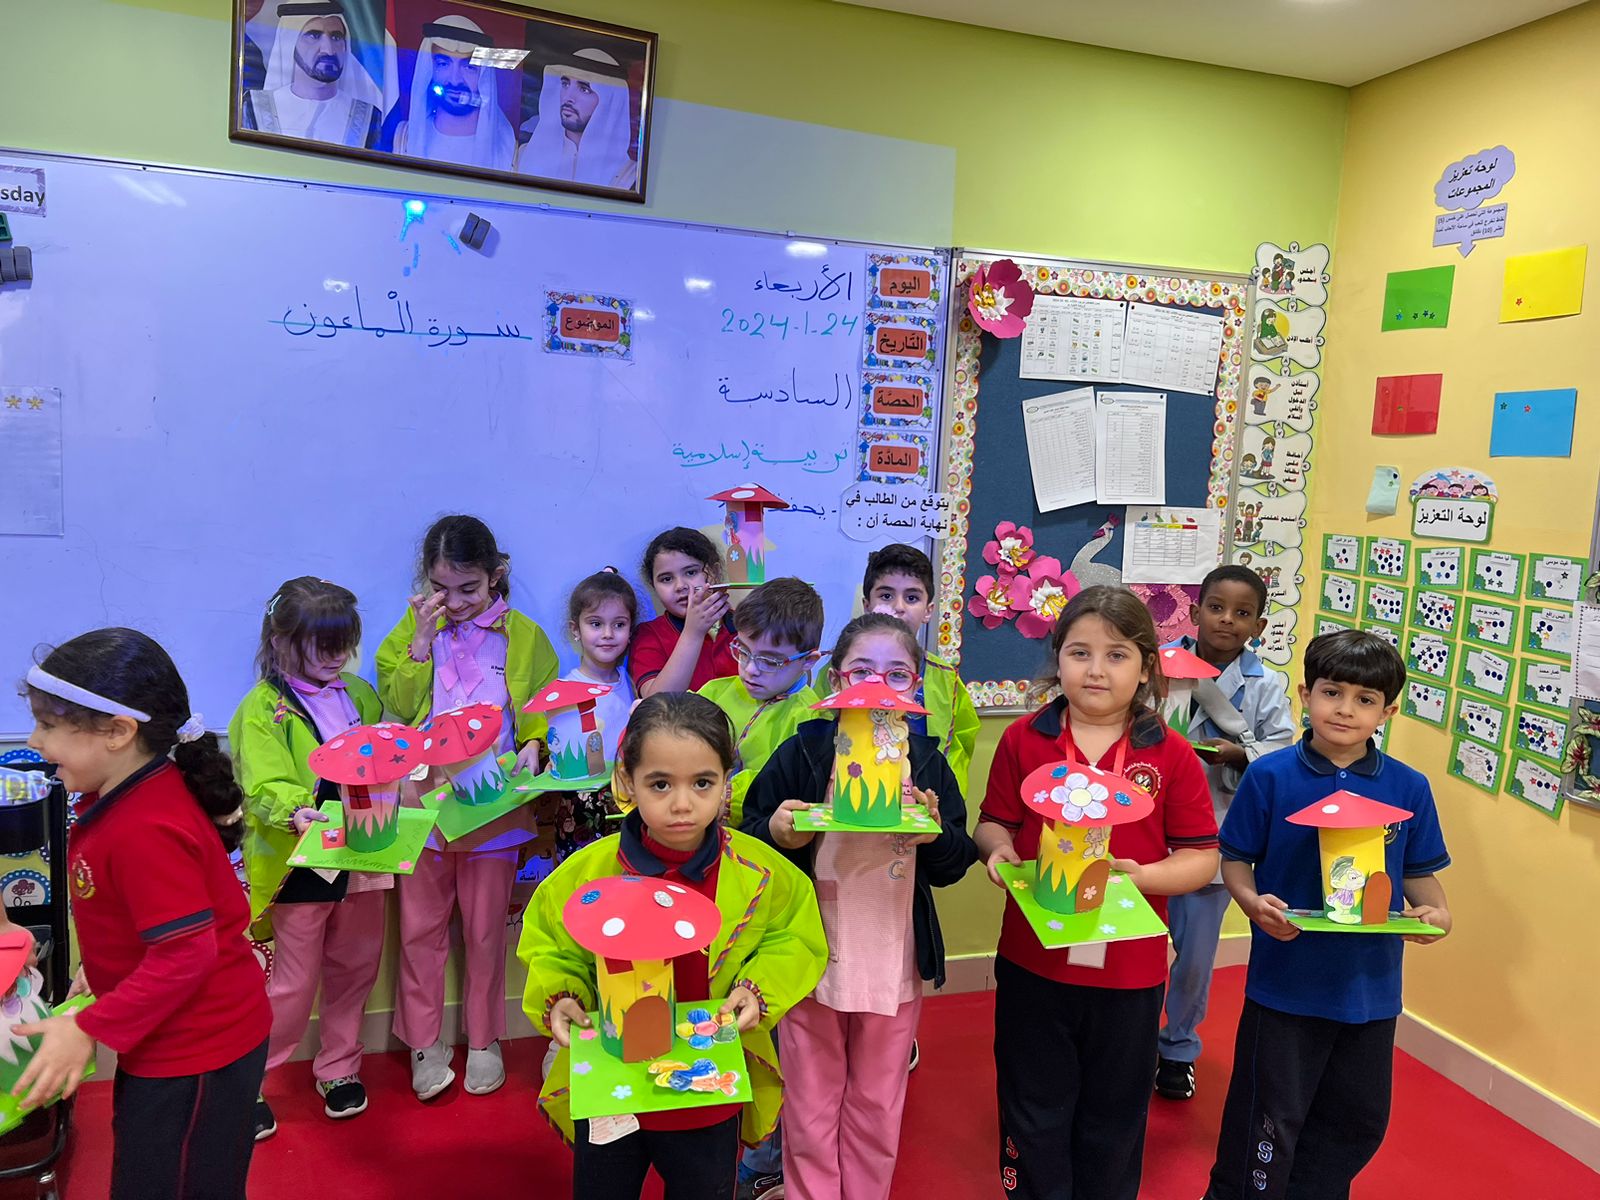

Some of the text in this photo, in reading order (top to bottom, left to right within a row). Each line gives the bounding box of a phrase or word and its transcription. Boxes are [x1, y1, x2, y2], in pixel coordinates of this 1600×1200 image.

[1448, 157, 1499, 183] لوحة تعزيز
[0, 185, 45, 207] sday
[1447, 177, 1496, 199] المجموعات
[754, 264, 852, 301] الأربعاء
[889, 276, 920, 295] اليوم
[427, 318, 521, 347] سورة
[565, 316, 615, 331] الموضوع
[718, 367, 852, 410] السادسة
[845, 490, 862, 508] في
[864, 492, 897, 507] الطالب
[900, 496, 917, 509] من
[865, 511, 880, 529] أن
[881, 513, 917, 529] الحصة
[919, 515, 948, 533] نهاية
[1416, 506, 1488, 529] لوحة التعزيز
